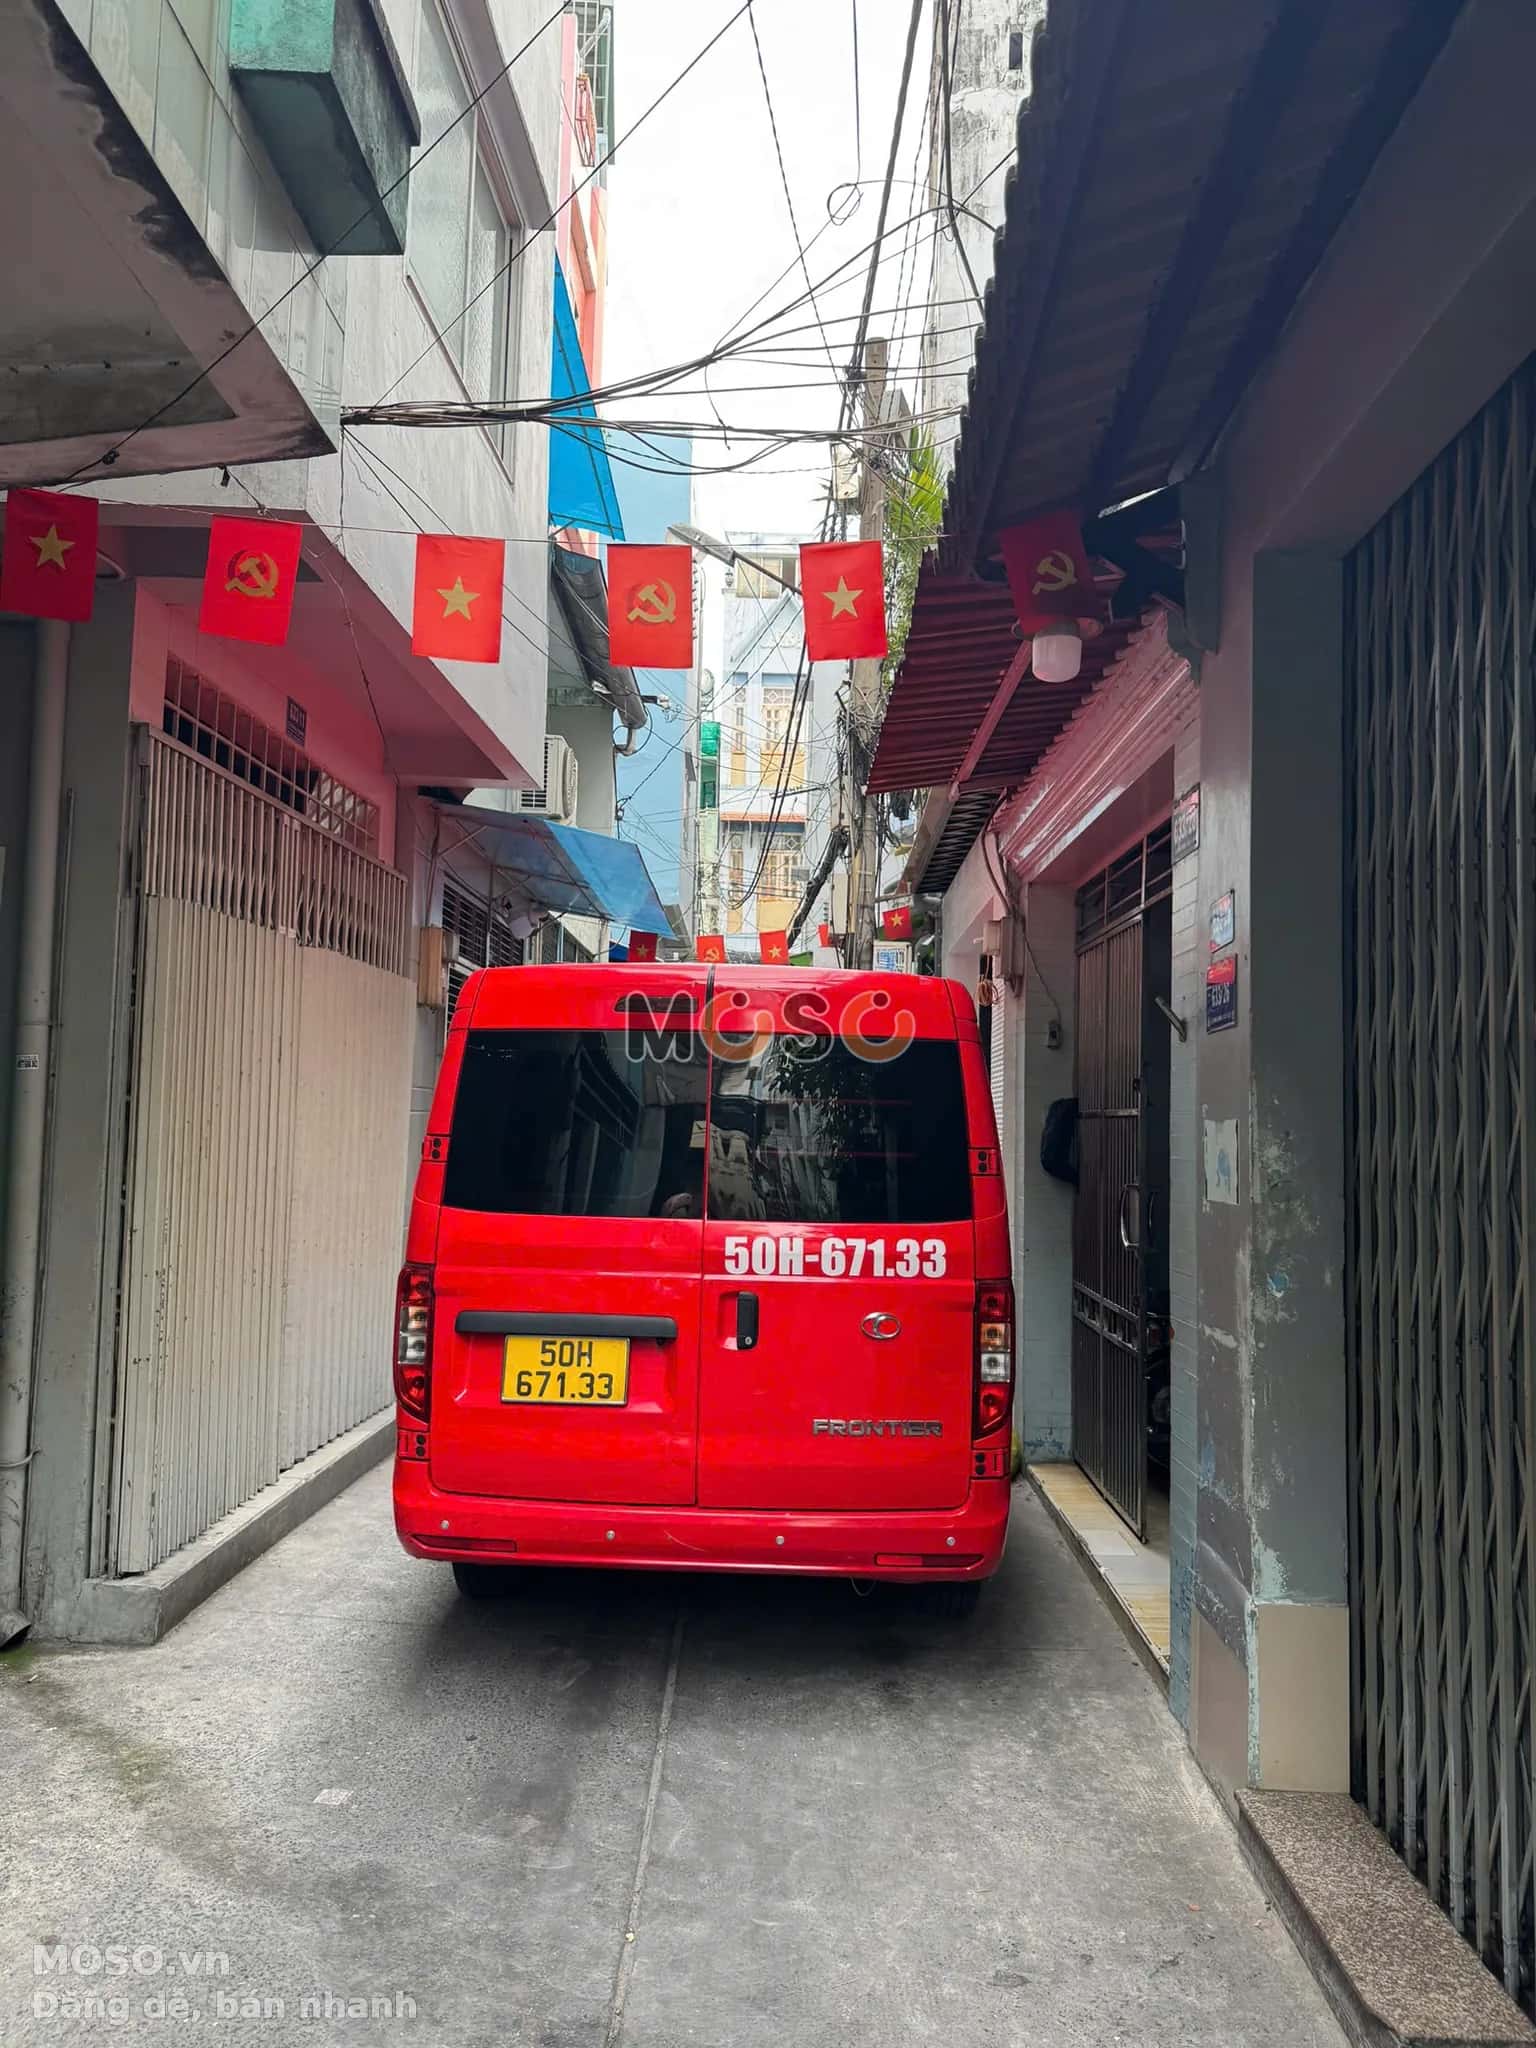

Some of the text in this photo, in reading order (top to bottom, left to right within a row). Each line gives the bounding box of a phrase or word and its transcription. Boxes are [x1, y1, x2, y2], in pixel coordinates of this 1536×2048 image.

[724, 1236, 947, 1278] 50H-671.33
[540, 1340, 593, 1367] 50H
[516, 1370, 613, 1399] 671.33
[812, 1418, 943, 1437] FRONTIER
